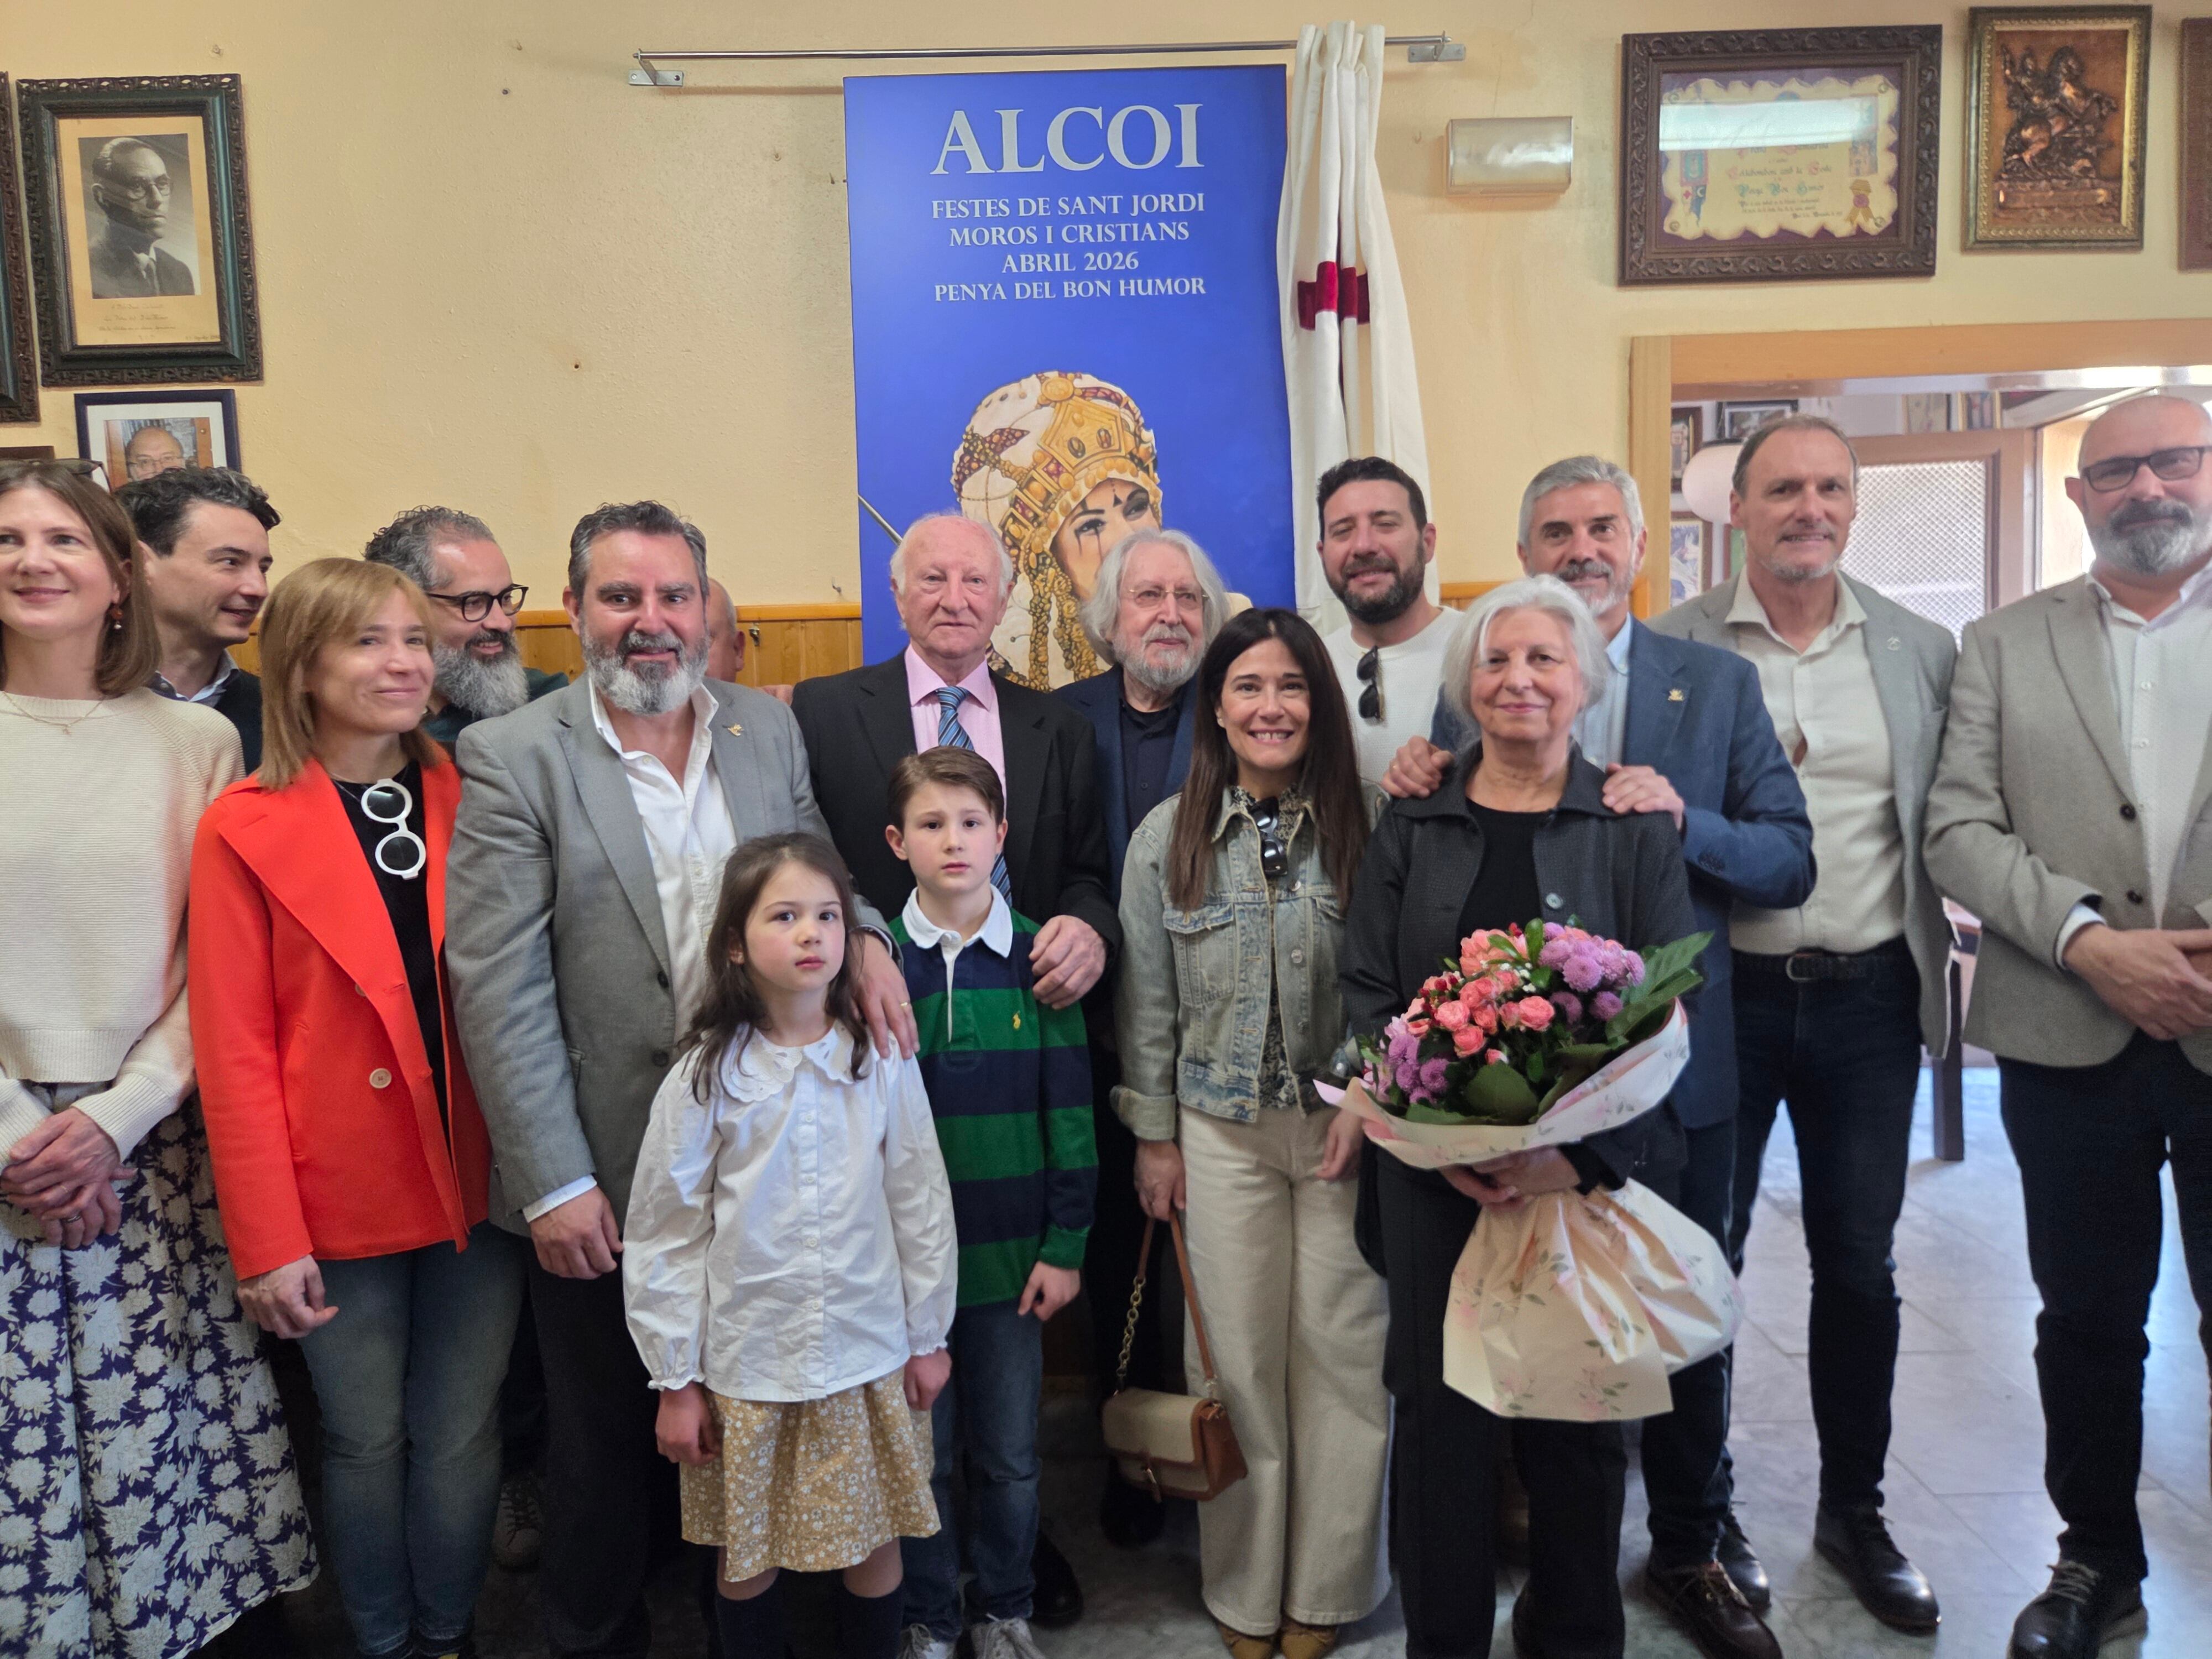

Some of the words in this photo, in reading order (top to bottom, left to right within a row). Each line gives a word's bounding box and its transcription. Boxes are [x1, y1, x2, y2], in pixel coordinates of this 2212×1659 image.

[930, 104, 1204, 175] ALCOI
[932, 199, 1010, 219] FESTES
[1018, 198, 1051, 217] DE
[1058, 195, 1124, 215] SANT
[1130, 193, 1205, 216] JORDI
[950, 226, 1037, 247] MOROS
[1046, 226, 1053, 243] I
[1061, 222, 1190, 243] CRISTIANS
[1002, 253, 1076, 273] ABRIL
[1084, 252, 1139, 271] 2026
[935, 283, 1007, 301] PENYA
[1015, 282, 1056, 299] DEL
[1063, 280, 1111, 298] BON
[1119, 278, 1207, 296] HUMOR
